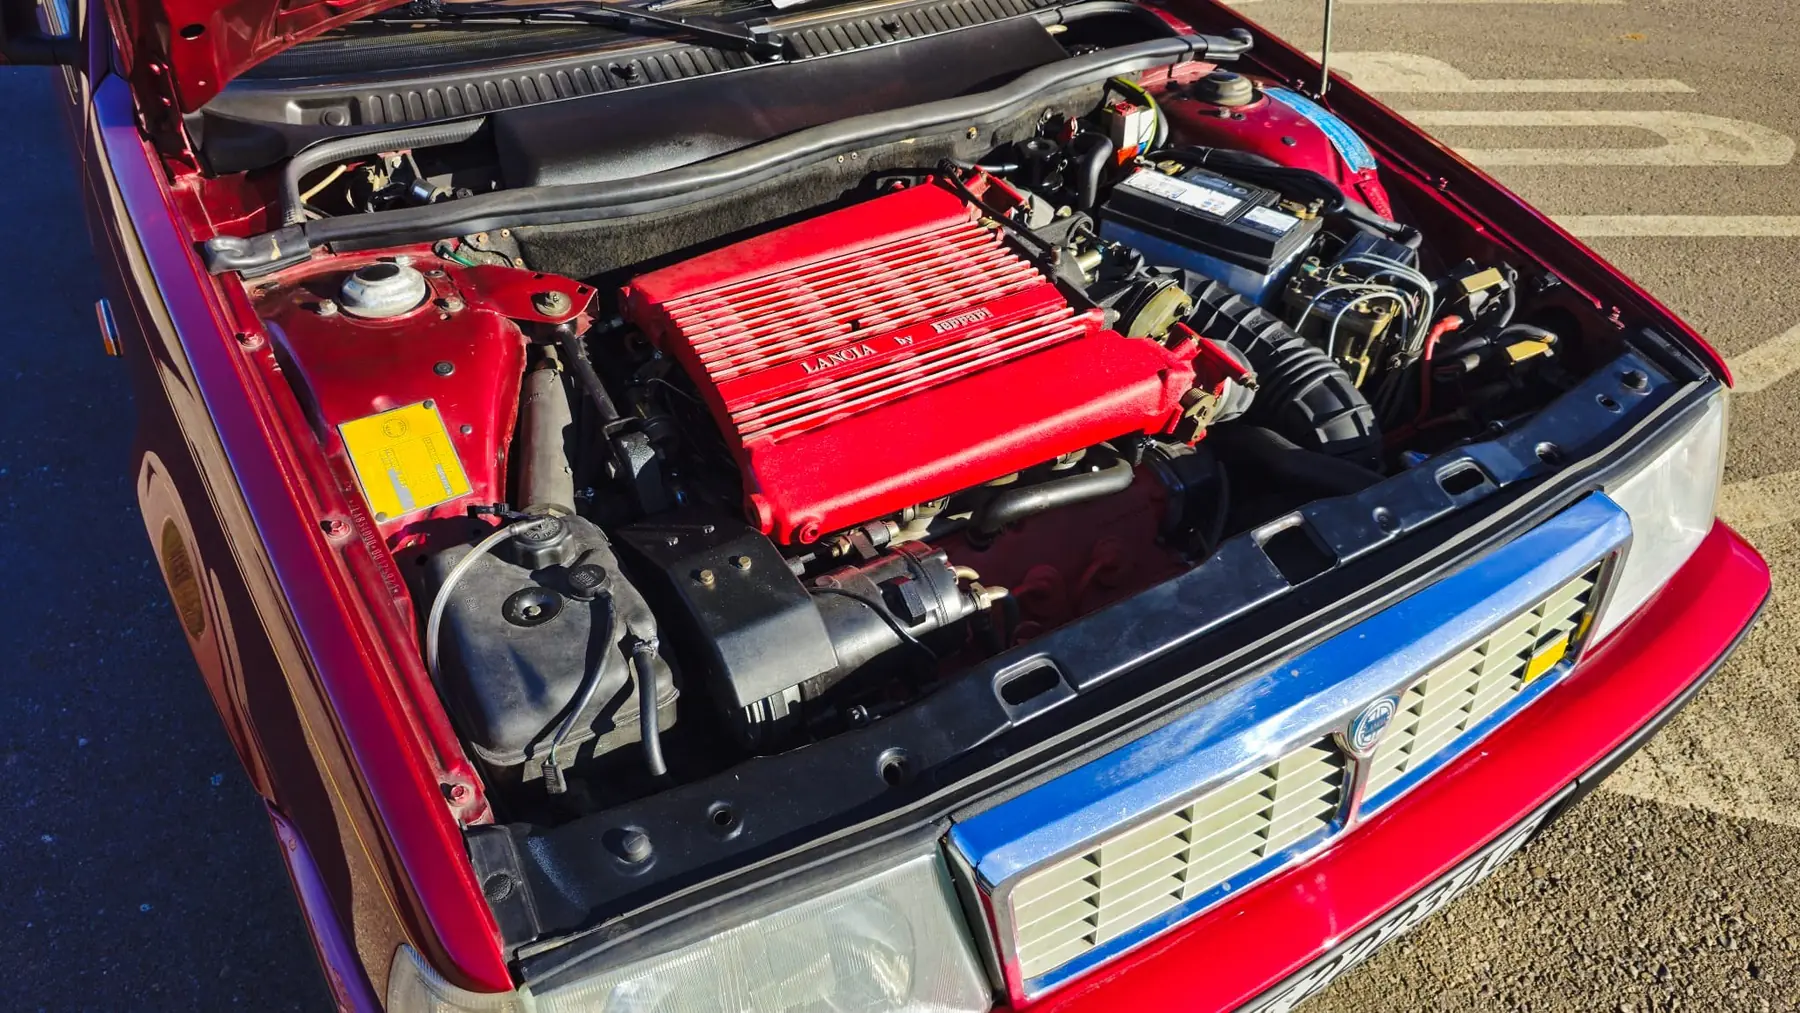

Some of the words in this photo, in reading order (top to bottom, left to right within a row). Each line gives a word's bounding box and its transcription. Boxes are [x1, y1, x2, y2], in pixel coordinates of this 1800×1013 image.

[800, 343, 877, 375] LANCIA
[894, 334, 913, 346] by
[930, 306, 994, 335] Ferrari
